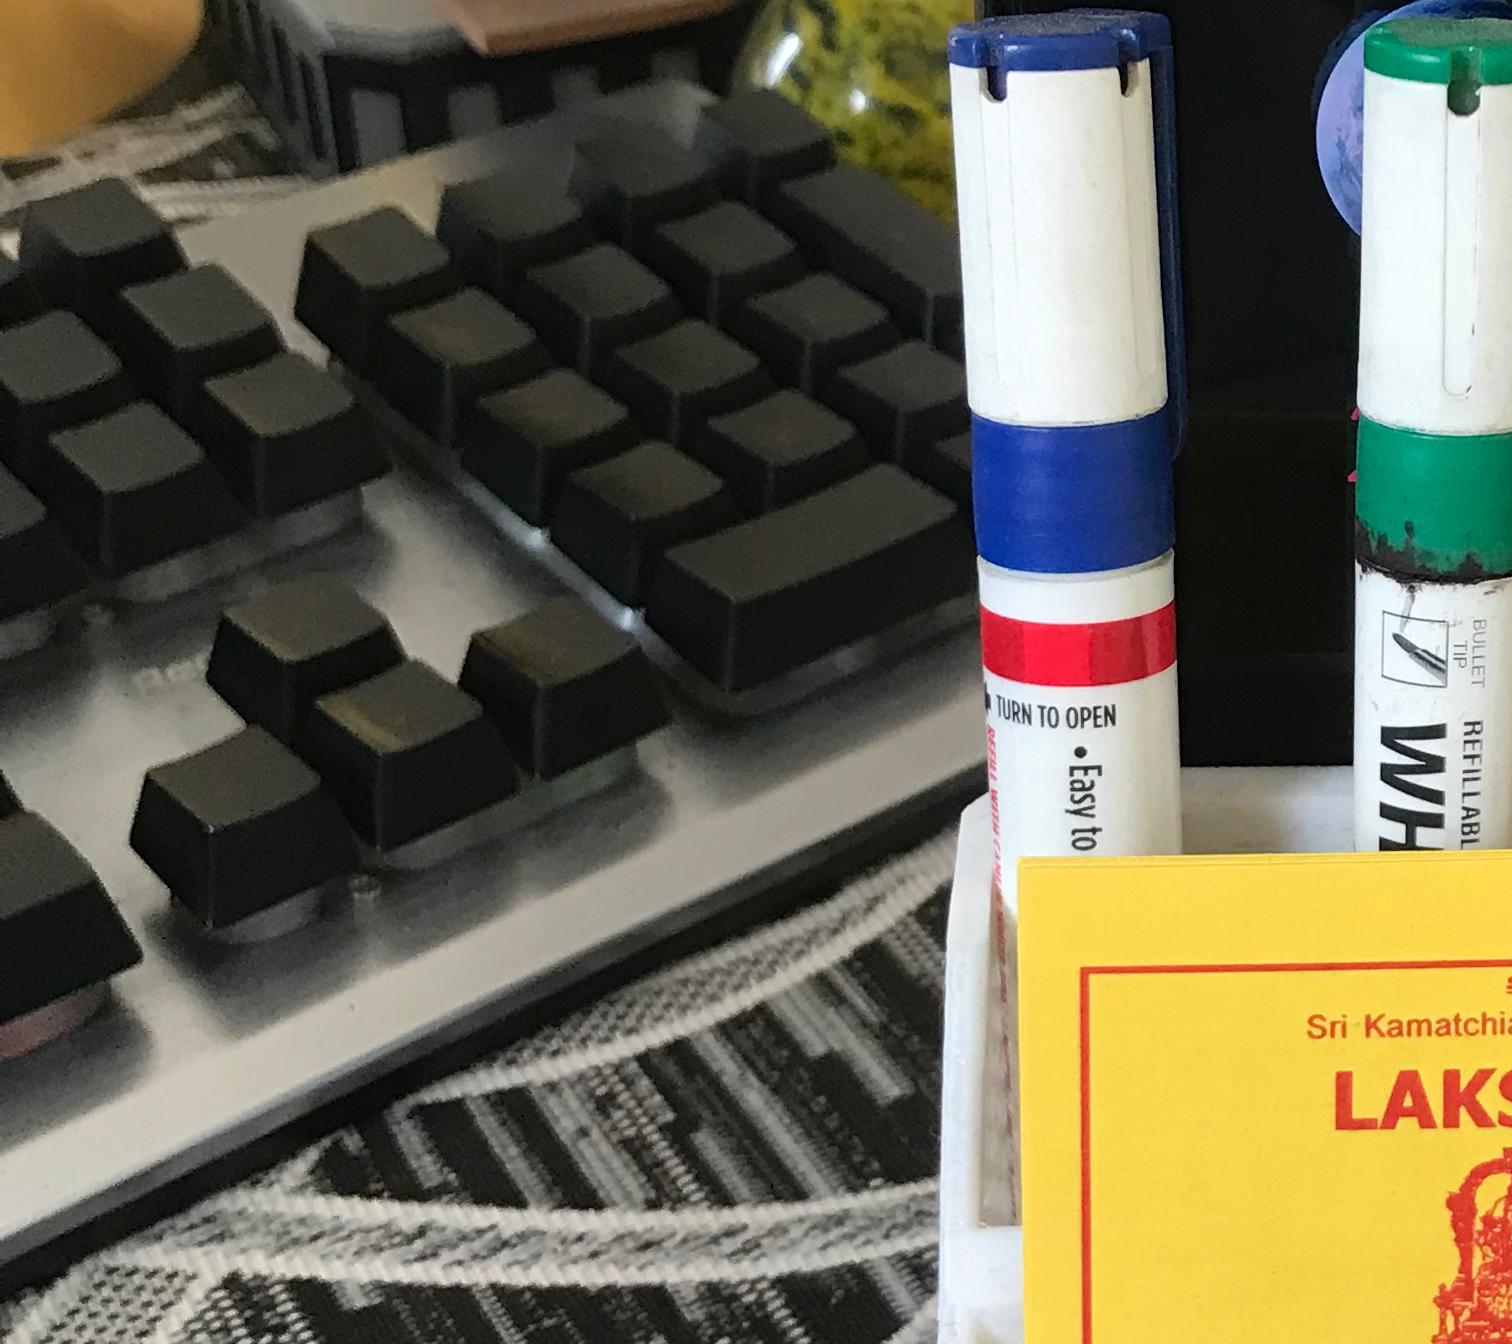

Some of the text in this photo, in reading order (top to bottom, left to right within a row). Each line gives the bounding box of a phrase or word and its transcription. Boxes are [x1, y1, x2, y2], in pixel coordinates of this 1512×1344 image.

[1453, 640, 1468, 669] TIP
[1471, 619, 1487, 688] BULLET
[996, 694, 1117, 730] TURN TO OPEN
[1064, 764, 1103, 852] Easy to
[1378, 723, 1448, 852] WH
[1460, 720, 1484, 850] REFILLABL
[1306, 1013, 1348, 1040] Sri
